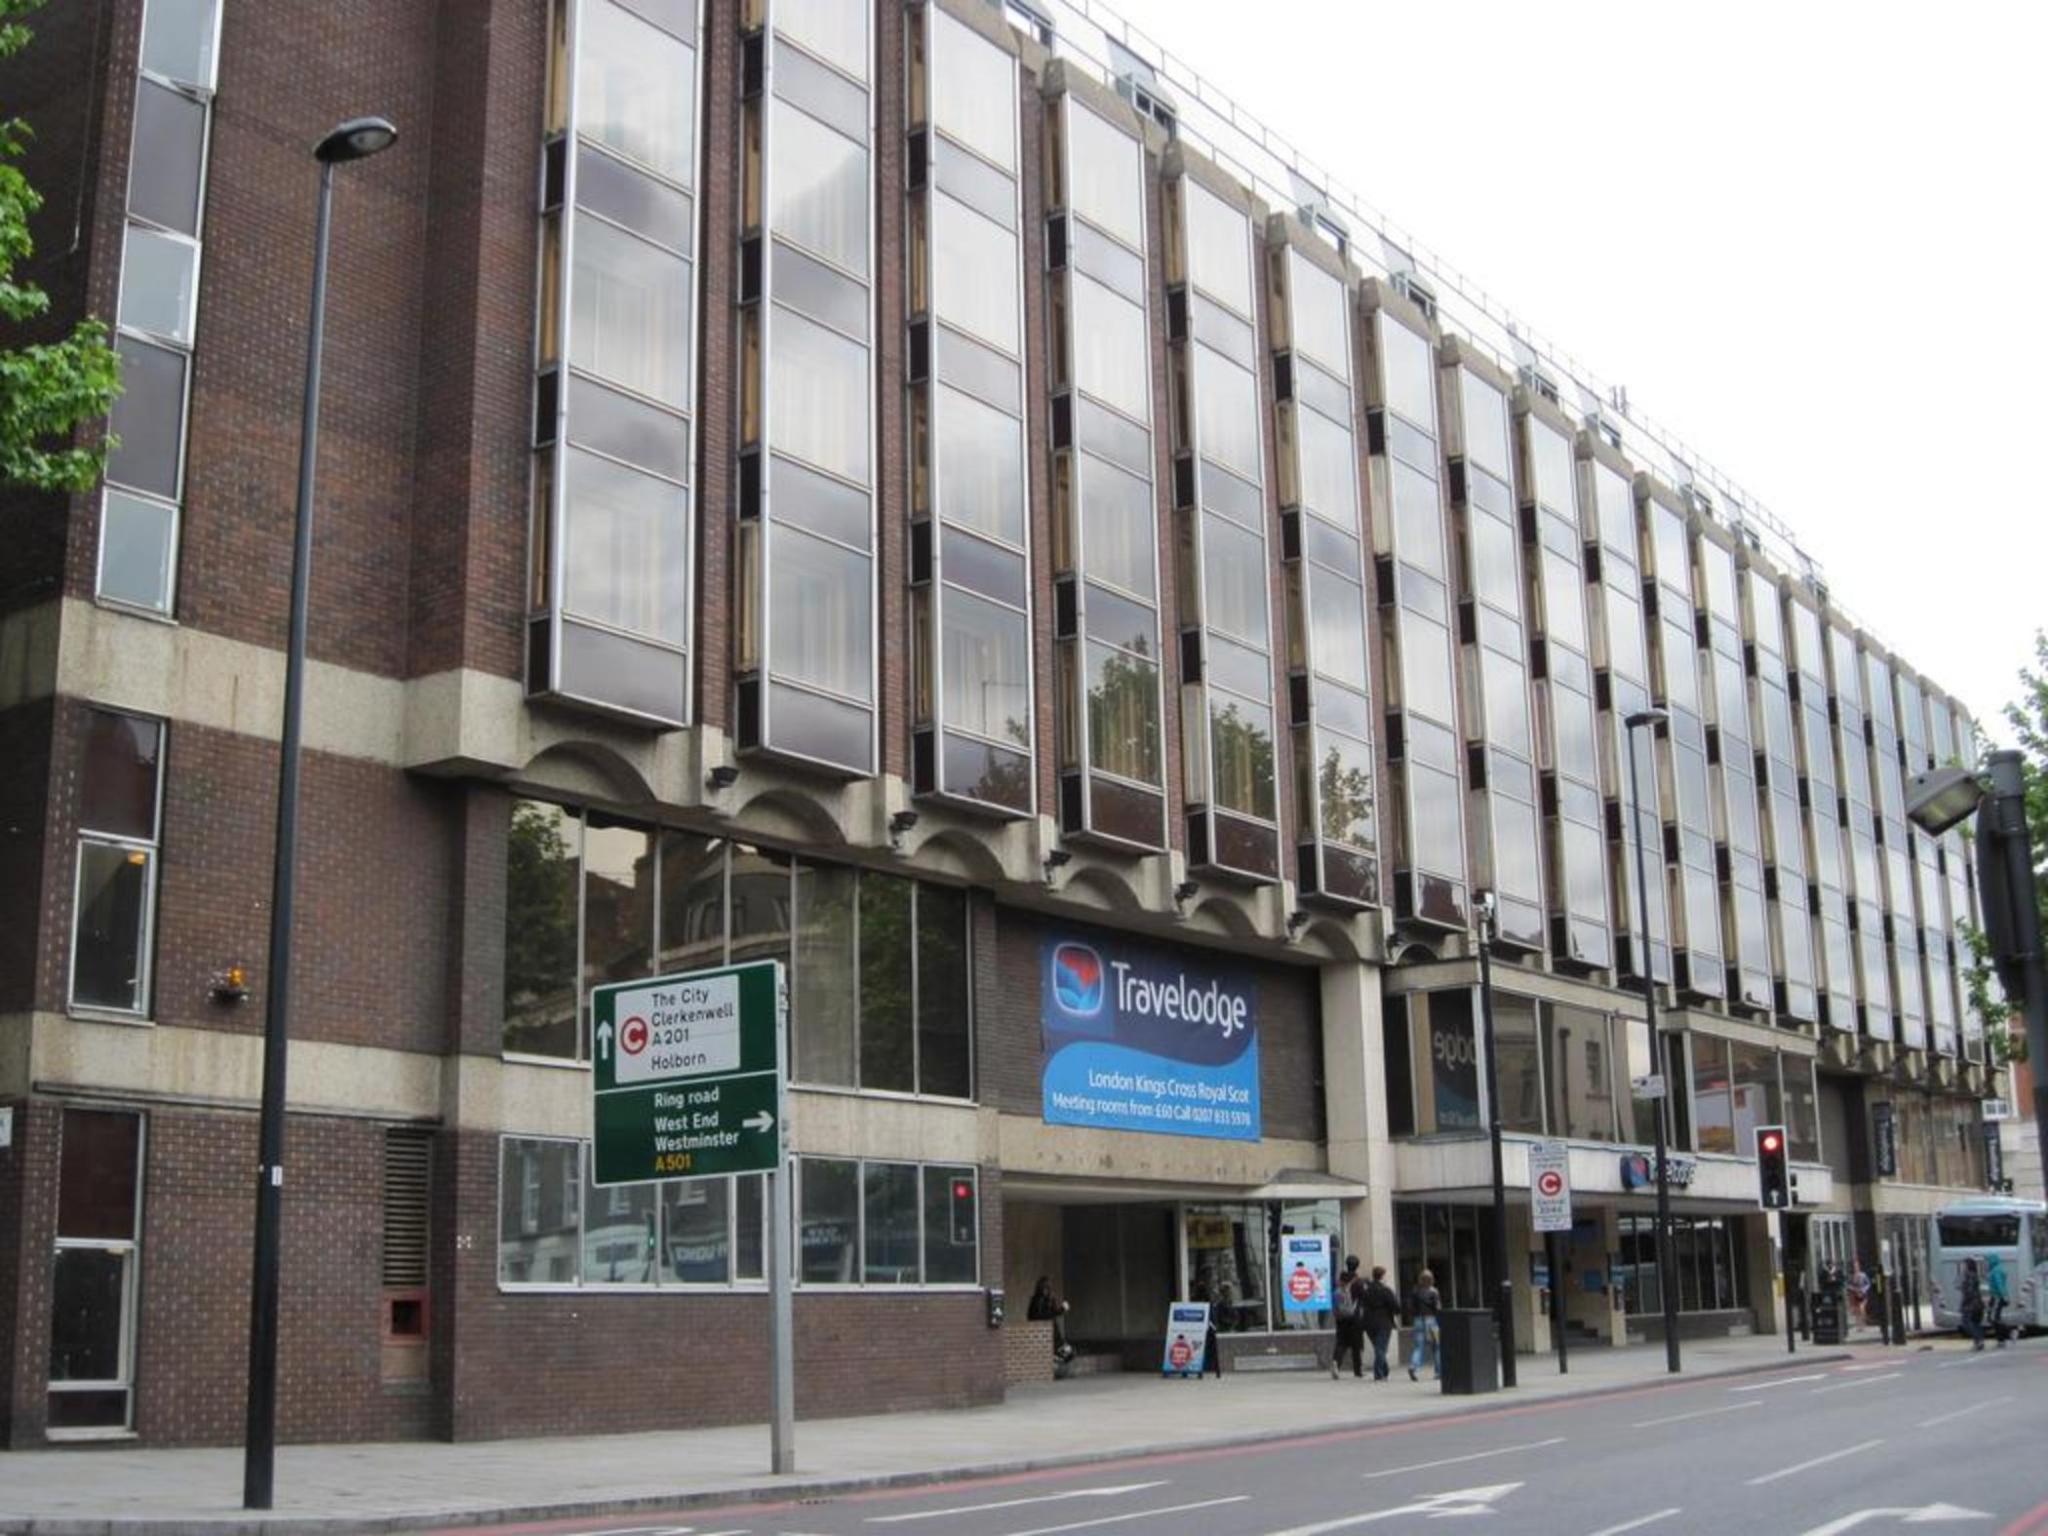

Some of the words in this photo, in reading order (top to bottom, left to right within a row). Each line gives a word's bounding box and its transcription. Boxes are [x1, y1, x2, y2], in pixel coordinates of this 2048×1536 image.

[652, 993, 676, 1007] The
[681, 987, 710, 1004] City
[1110, 961, 1247, 1038] Travelodge
[652, 1003, 734, 1027] Clerkenwell
[652, 1053, 707, 1071] Holborn
[654, 1092, 685, 1109] Ring
[687, 1085, 720, 1104] road
[1088, 1068, 1135, 1092] London
[1136, 1075, 1167, 1099] Kings
[1168, 1079, 1197, 1099] Cross
[1198, 1082, 1227, 1105] Royal
[1228, 1085, 1249, 1104] Scot
[1052, 1091, 1096, 1116] Meeting
[1097, 1100, 1129, 1115] rooms
[1130, 1099, 1154, 1117] from
[1174, 1104, 1191, 1121] Call
[654, 1115, 689, 1133] West
[693, 1110, 720, 1129] End
[654, 1131, 739, 1152] Westminster
[655, 1153, 691, 1172] A501
